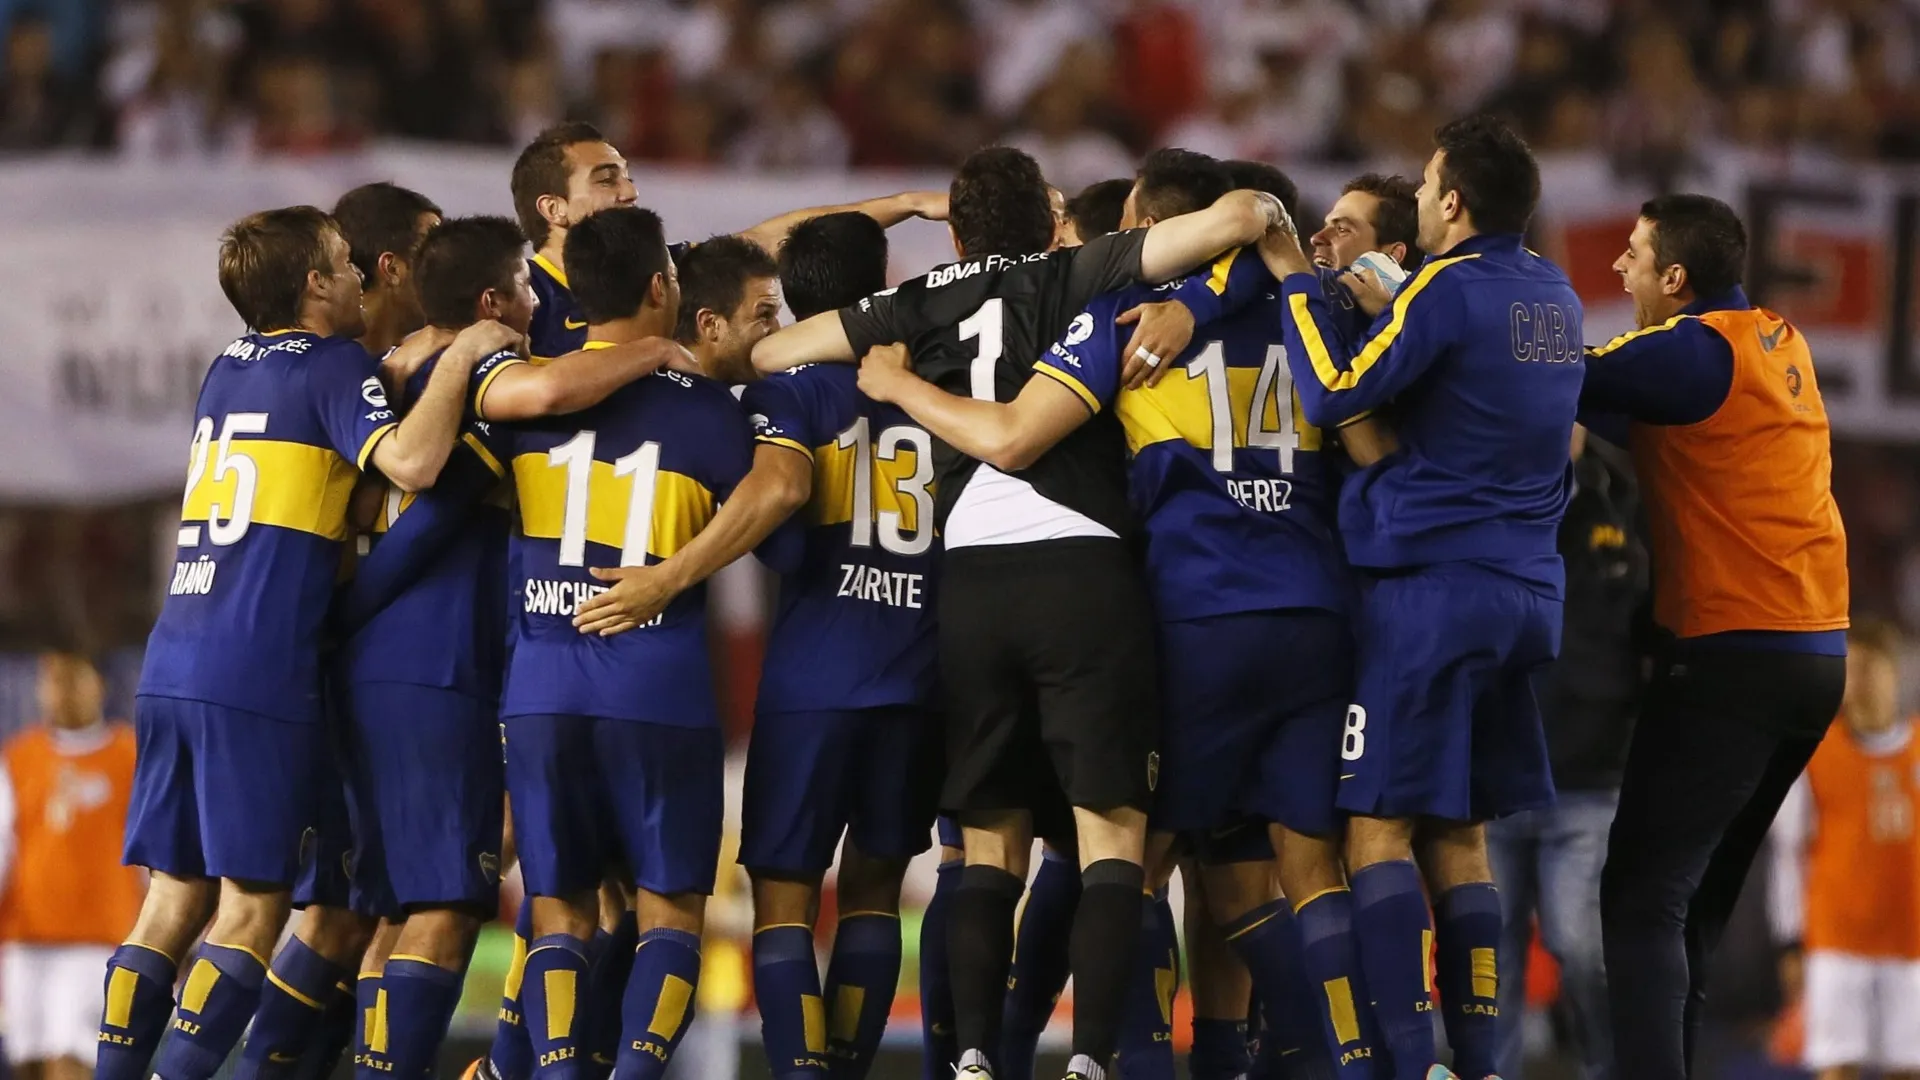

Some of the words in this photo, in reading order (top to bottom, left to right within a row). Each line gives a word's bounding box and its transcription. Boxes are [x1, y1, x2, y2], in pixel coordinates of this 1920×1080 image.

[925, 261, 981, 288] BBVA
[958, 297, 1003, 401] 1
[1510, 302, 1580, 363] CABJ
[1050, 341, 1082, 368] OTAL
[1186, 340, 1300, 474] 14
[177, 412, 269, 546] 25
[548, 429, 662, 568] 11
[837, 415, 936, 555] 13
[1226, 479, 1293, 512] PEREZ
[170, 554, 216, 596] RIAÑO
[837, 564, 923, 609] ZARATE
[525, 578, 611, 616] SANCH
[498, 1007, 520, 1025] ABJ
[1415, 1000, 1433, 1012] CA
[173, 1018, 201, 1036] ABJ
[540, 1046, 575, 1067] CABJ
